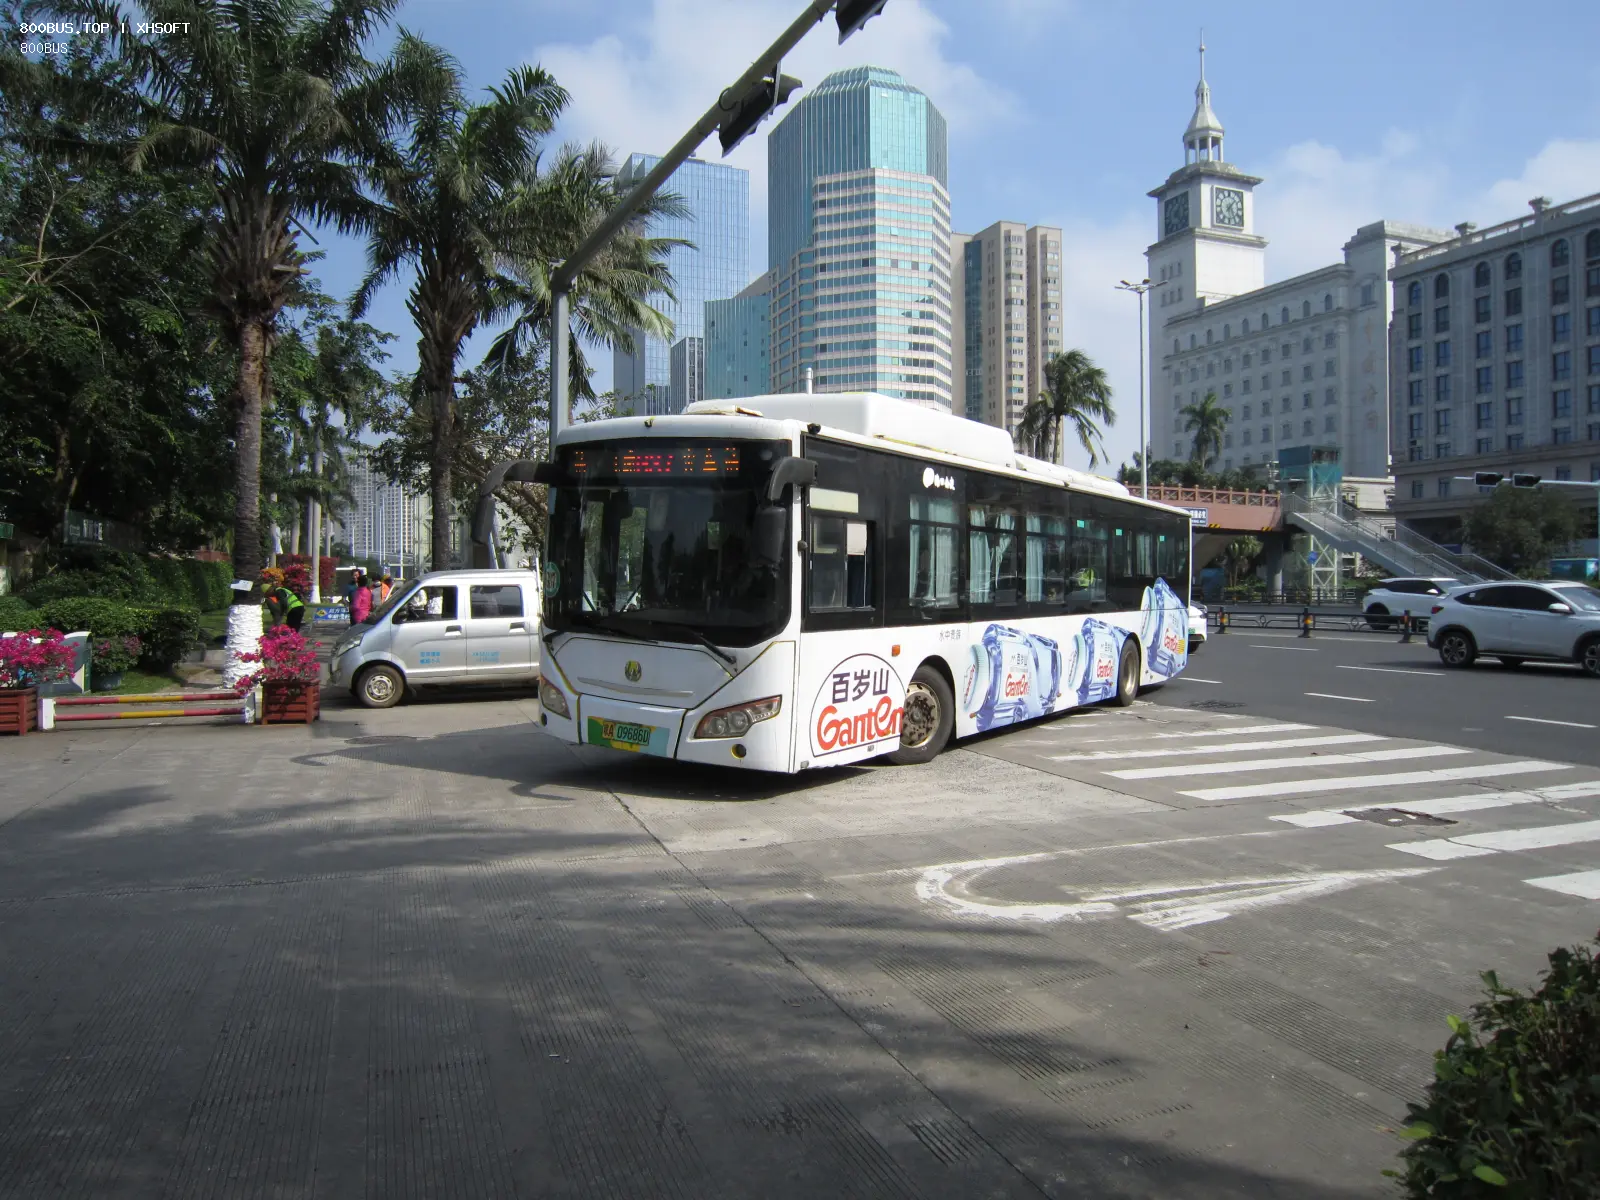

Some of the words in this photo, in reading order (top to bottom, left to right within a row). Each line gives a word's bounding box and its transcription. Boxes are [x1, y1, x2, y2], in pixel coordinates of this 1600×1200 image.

[832, 668, 889, 704] 百岁山
[817, 696, 904, 750] Ganten
